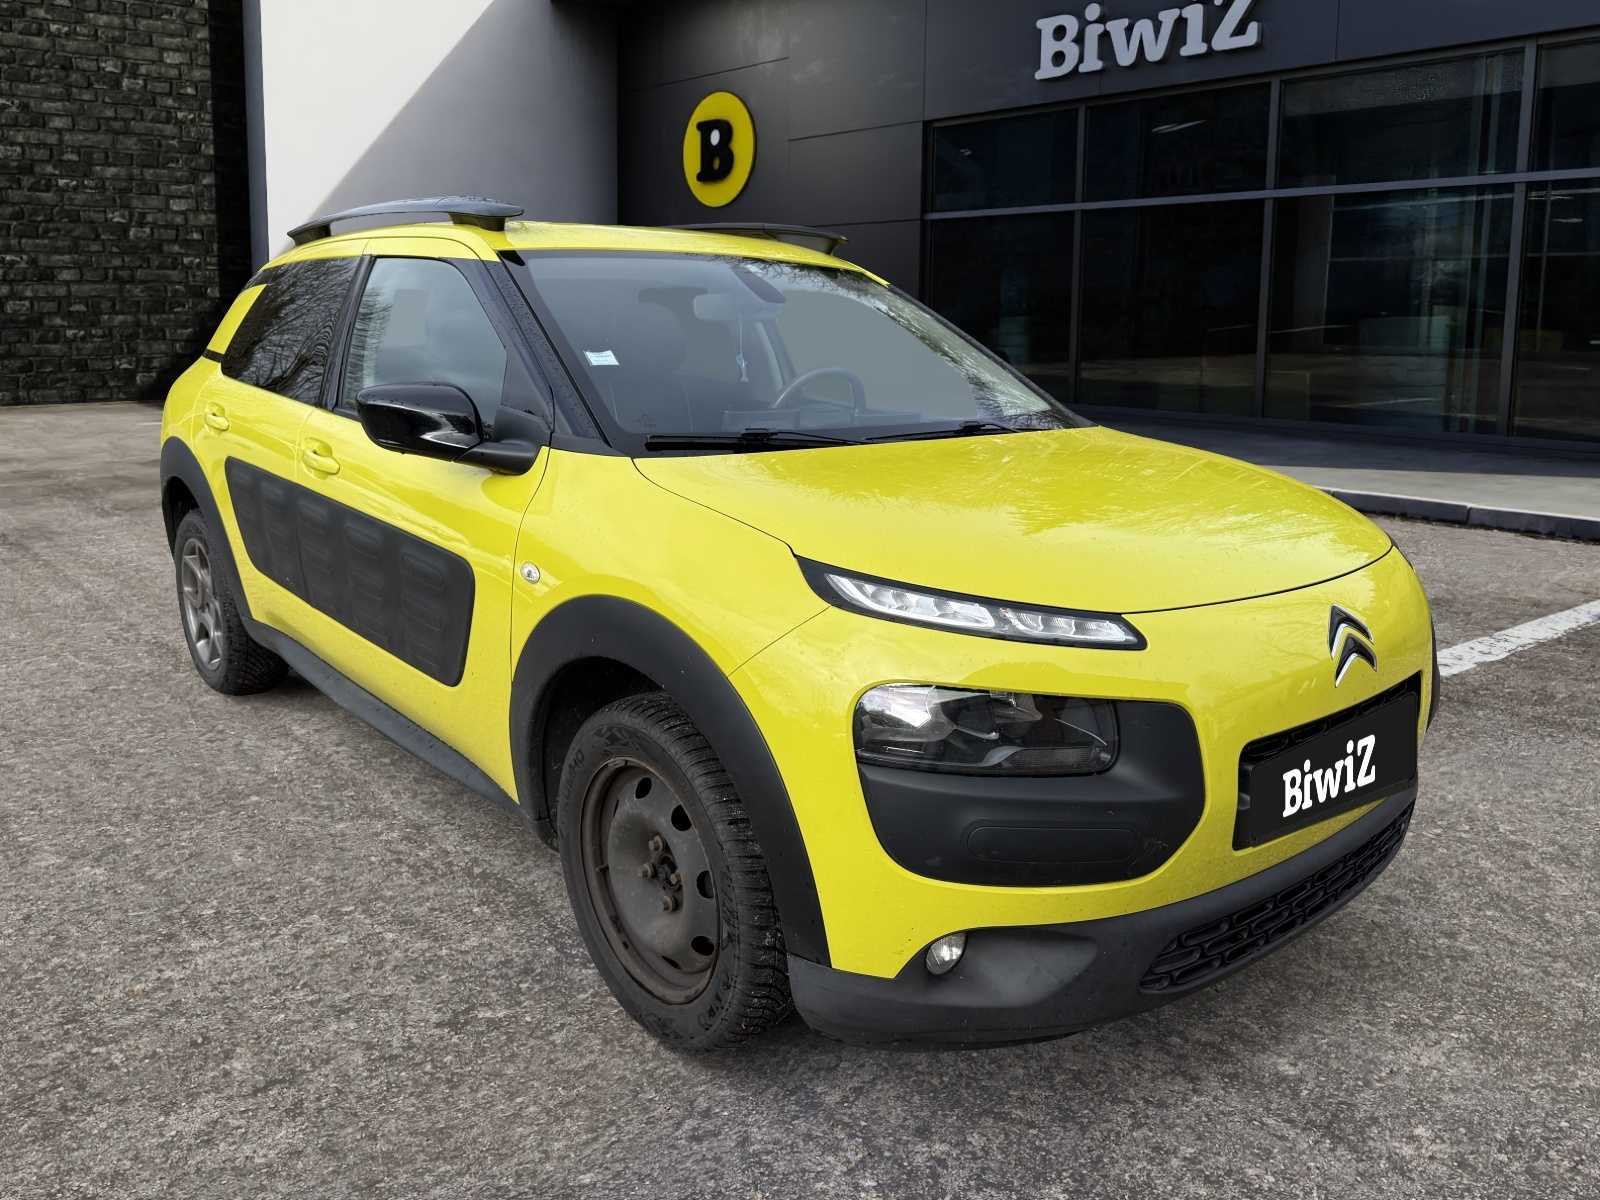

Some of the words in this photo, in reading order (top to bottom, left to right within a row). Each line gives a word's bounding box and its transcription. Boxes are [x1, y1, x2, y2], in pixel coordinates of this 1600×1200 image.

[1034, 0, 1259, 80] BiwiZ
[696, 119, 735, 183] B
[1282, 734, 1376, 818] BiwiZ
